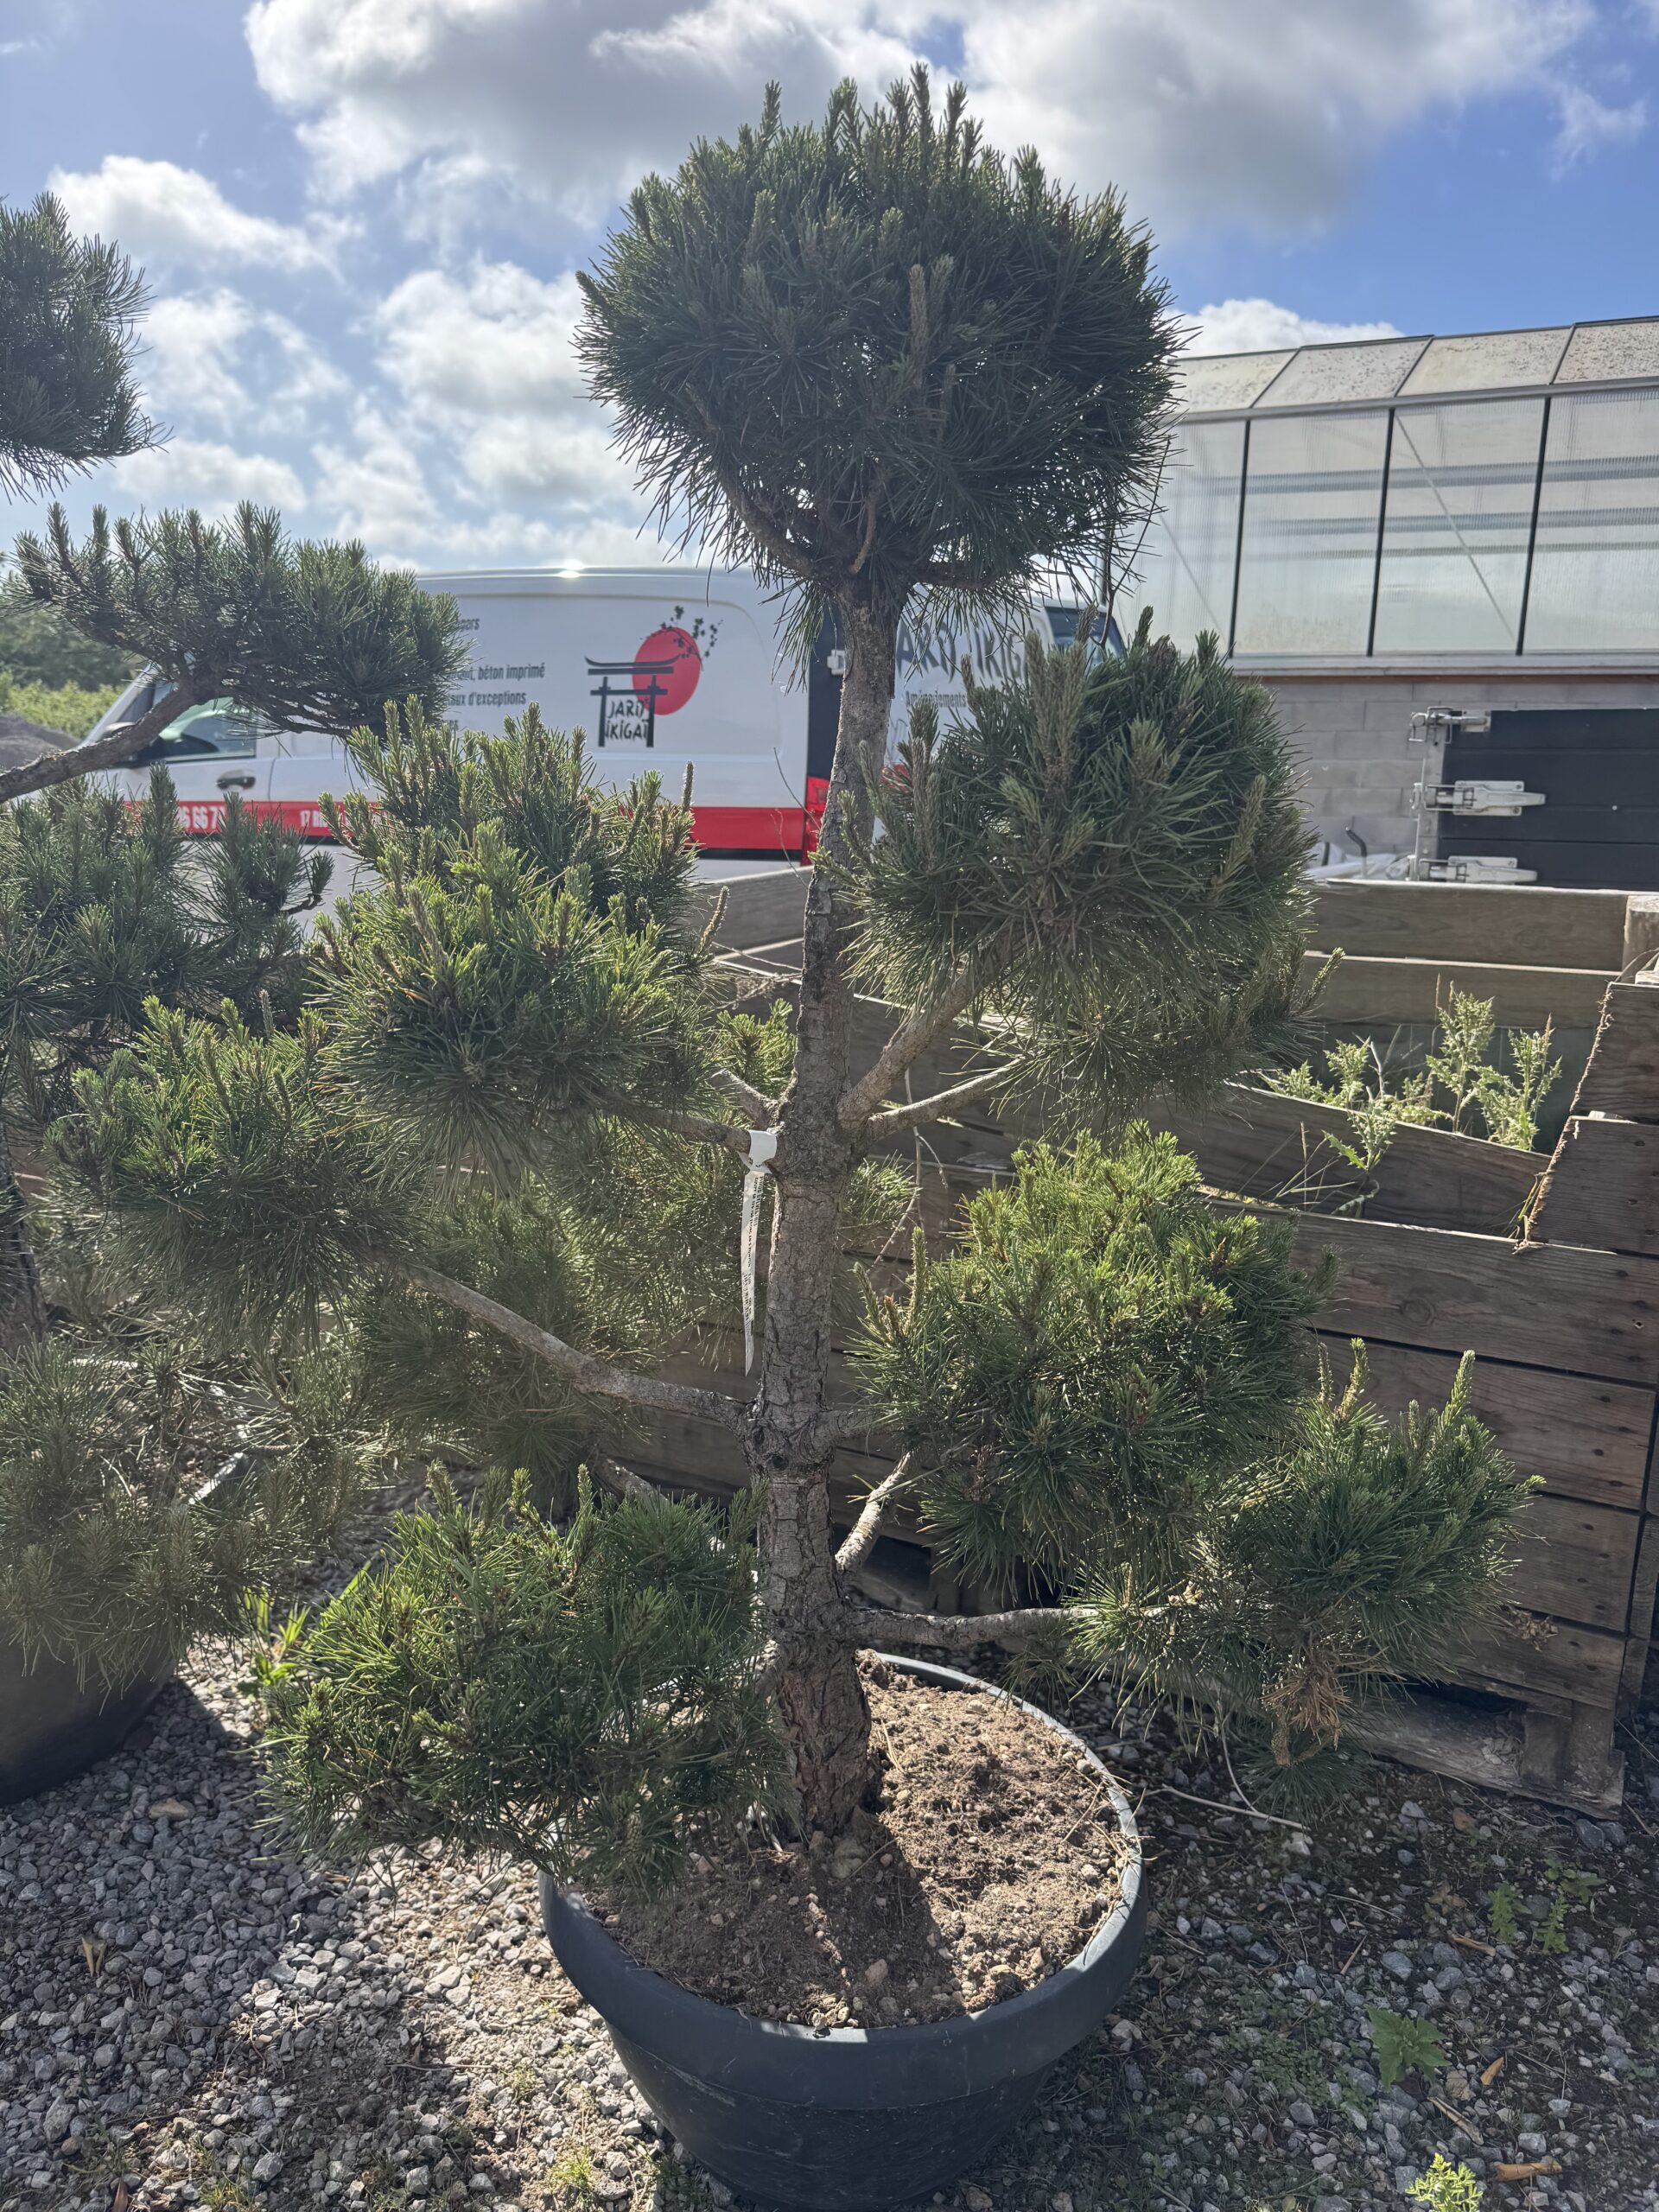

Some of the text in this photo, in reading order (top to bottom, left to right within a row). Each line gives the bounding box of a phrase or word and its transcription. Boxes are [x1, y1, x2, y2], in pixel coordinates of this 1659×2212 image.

[478, 664, 504, 680] béton
[506, 663, 545, 681] imprimé
[467, 690, 526, 707] d'exceptions
[192, 806, 208, 829] 66
